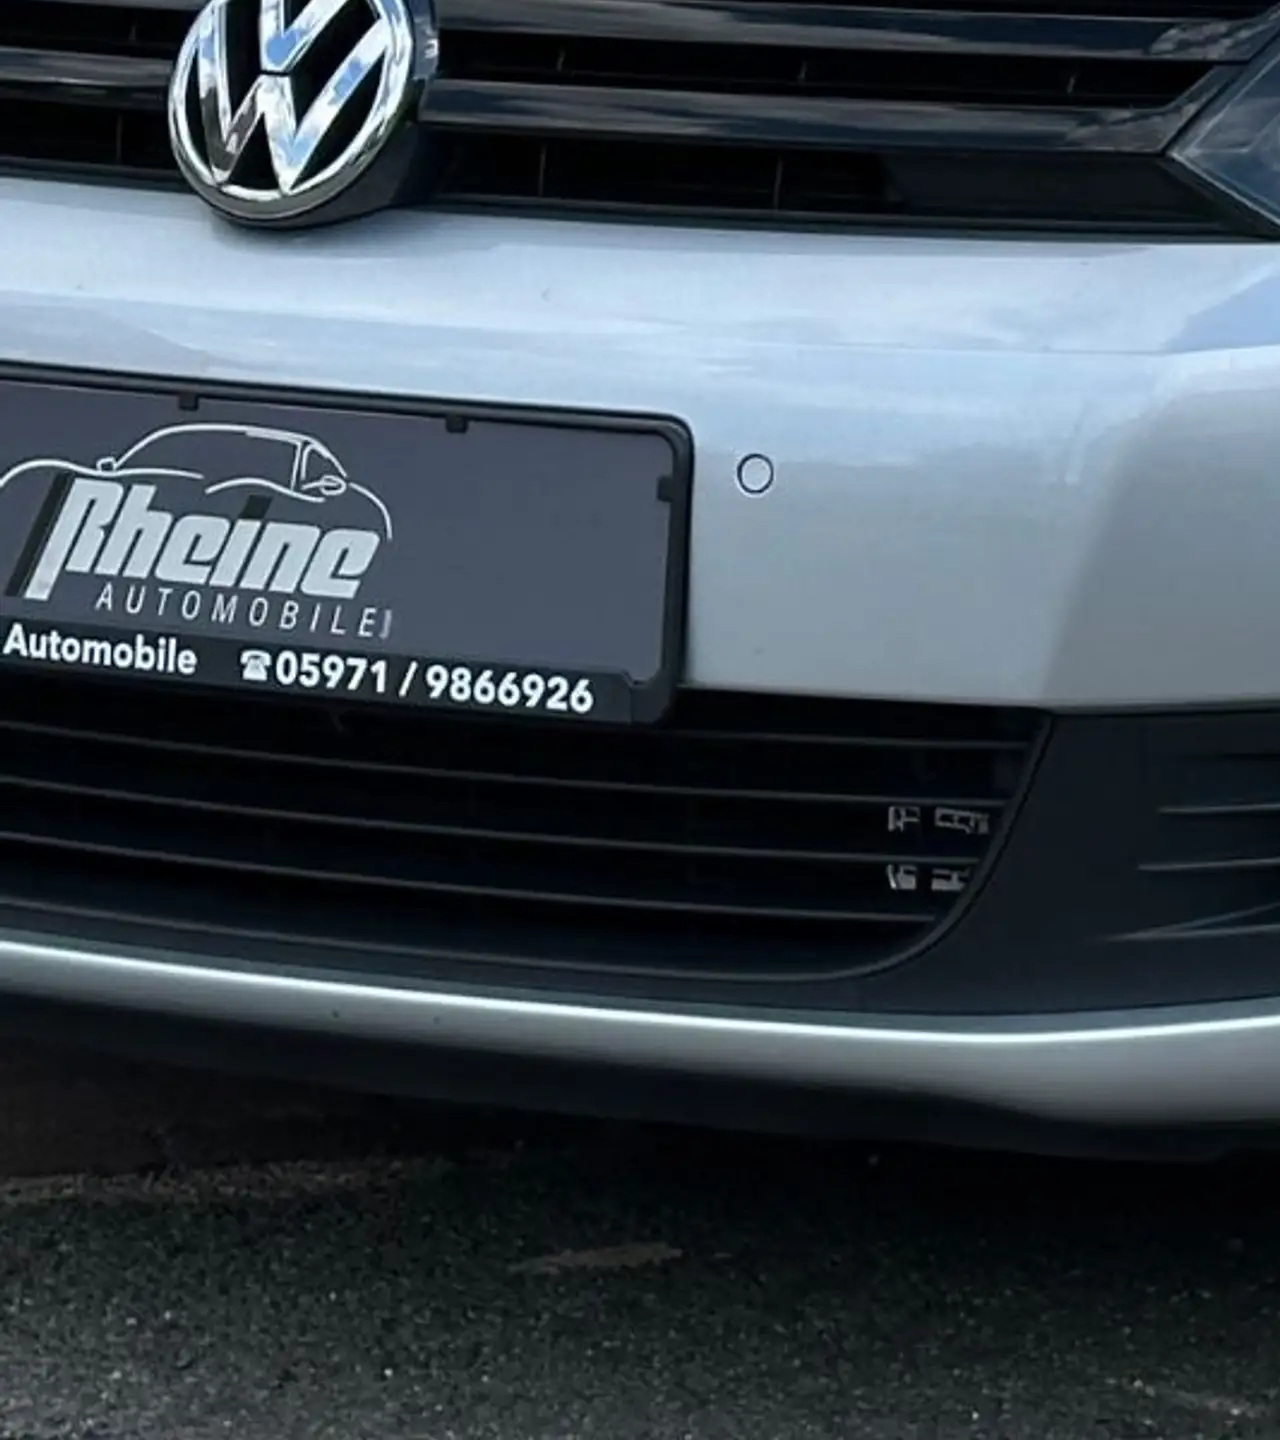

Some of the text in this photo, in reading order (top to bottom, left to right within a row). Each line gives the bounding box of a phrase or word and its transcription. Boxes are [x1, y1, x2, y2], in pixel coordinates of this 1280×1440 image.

[24, 475, 382, 601] Rheine
[2, 622, 198, 675] Automobile
[275, 650, 386, 694] 05971
[426, 664, 595, 714] 9866926
